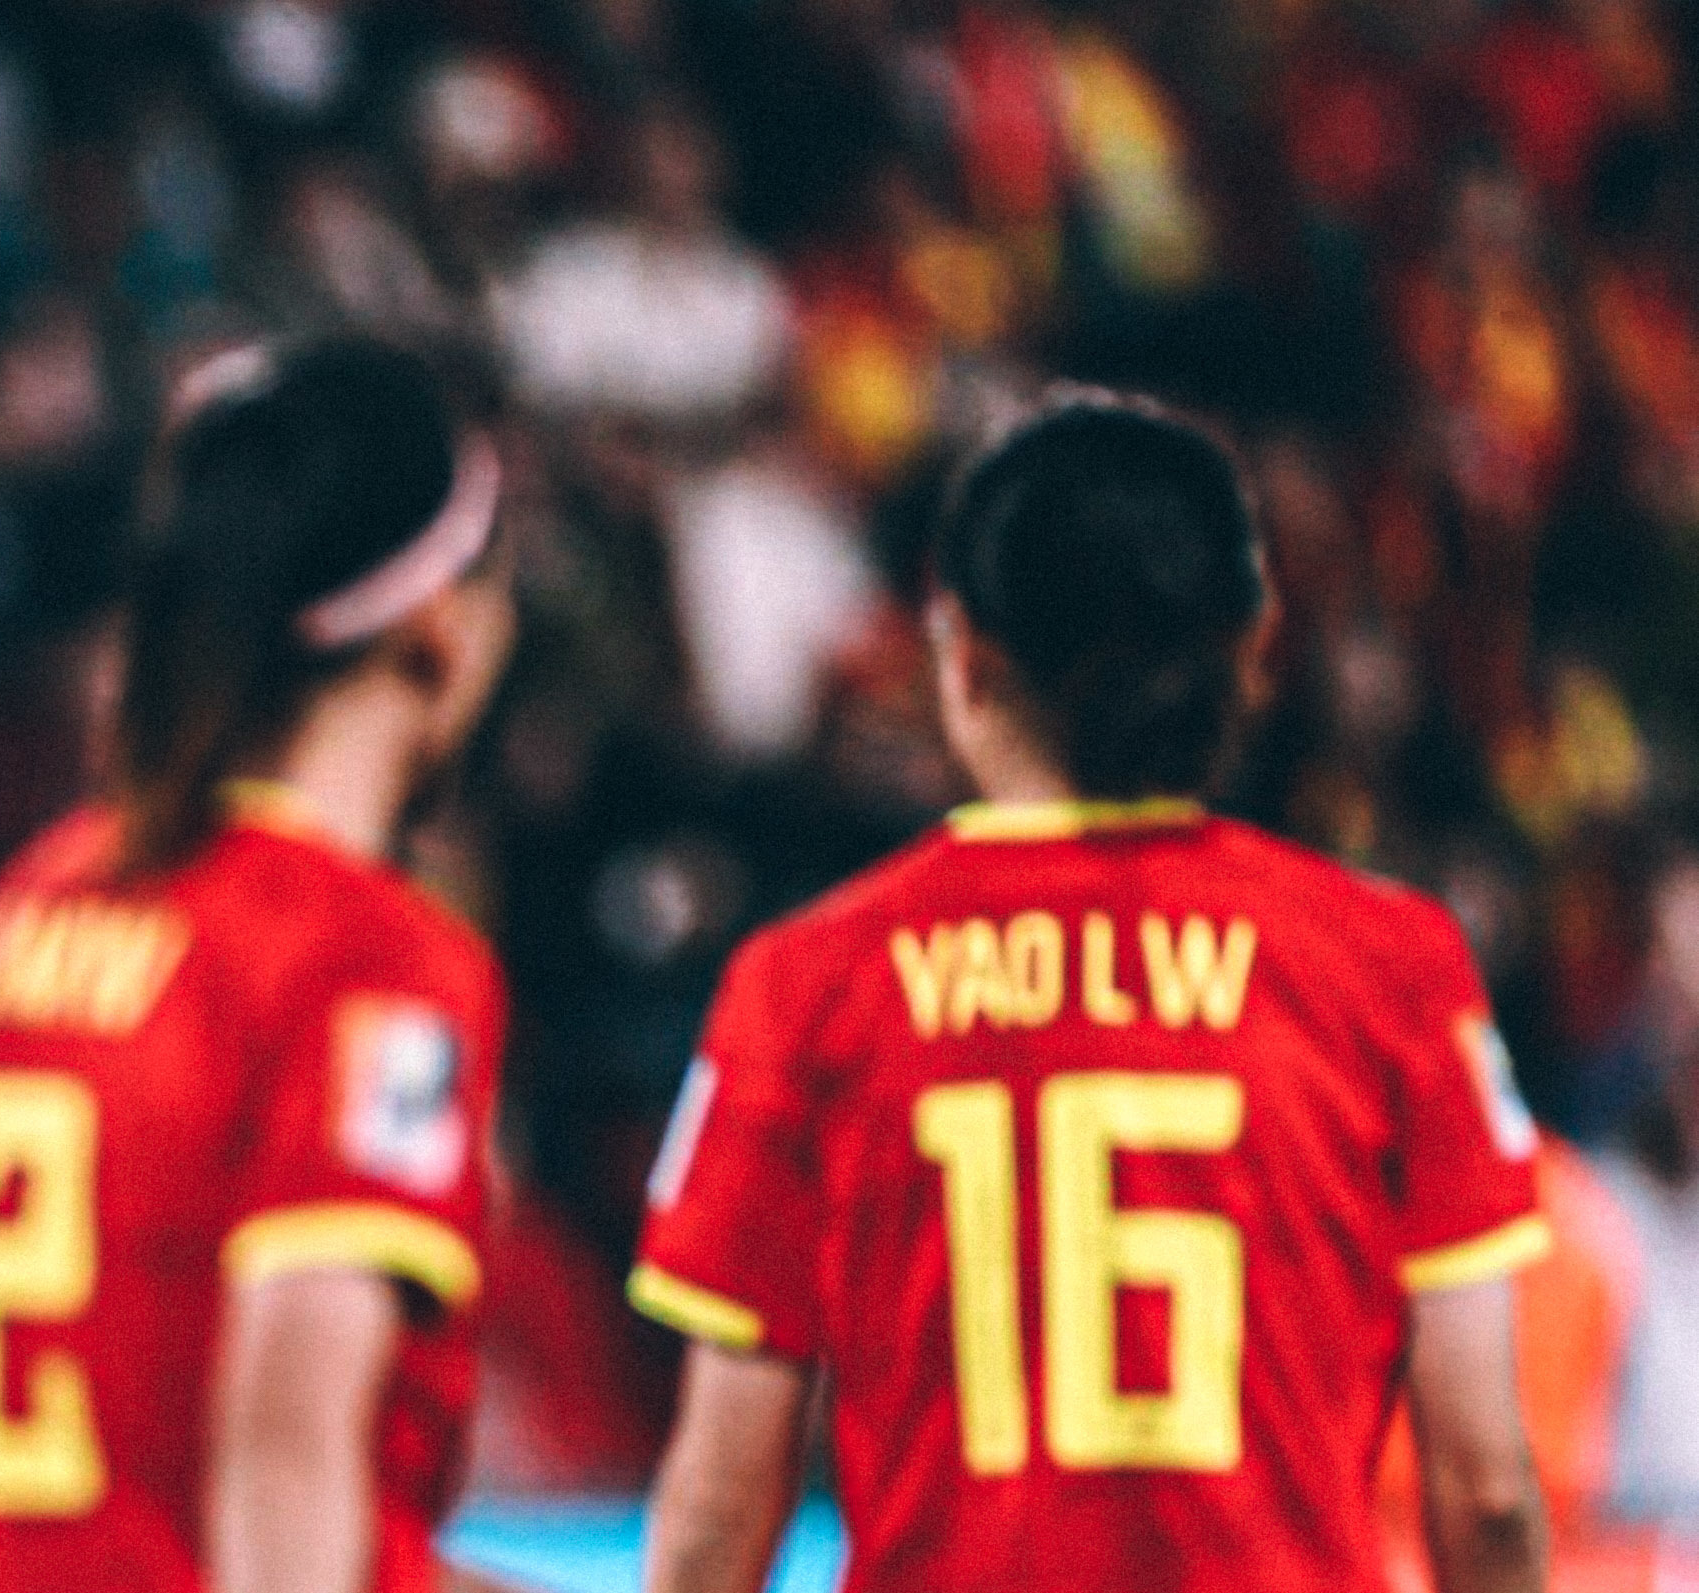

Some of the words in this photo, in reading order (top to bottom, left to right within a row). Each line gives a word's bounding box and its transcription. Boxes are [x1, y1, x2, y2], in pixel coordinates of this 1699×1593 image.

[890, 910, 1063, 1040] YAO
[1081, 911, 1257, 1031] LW
[912, 1071, 1246, 1478] 16
